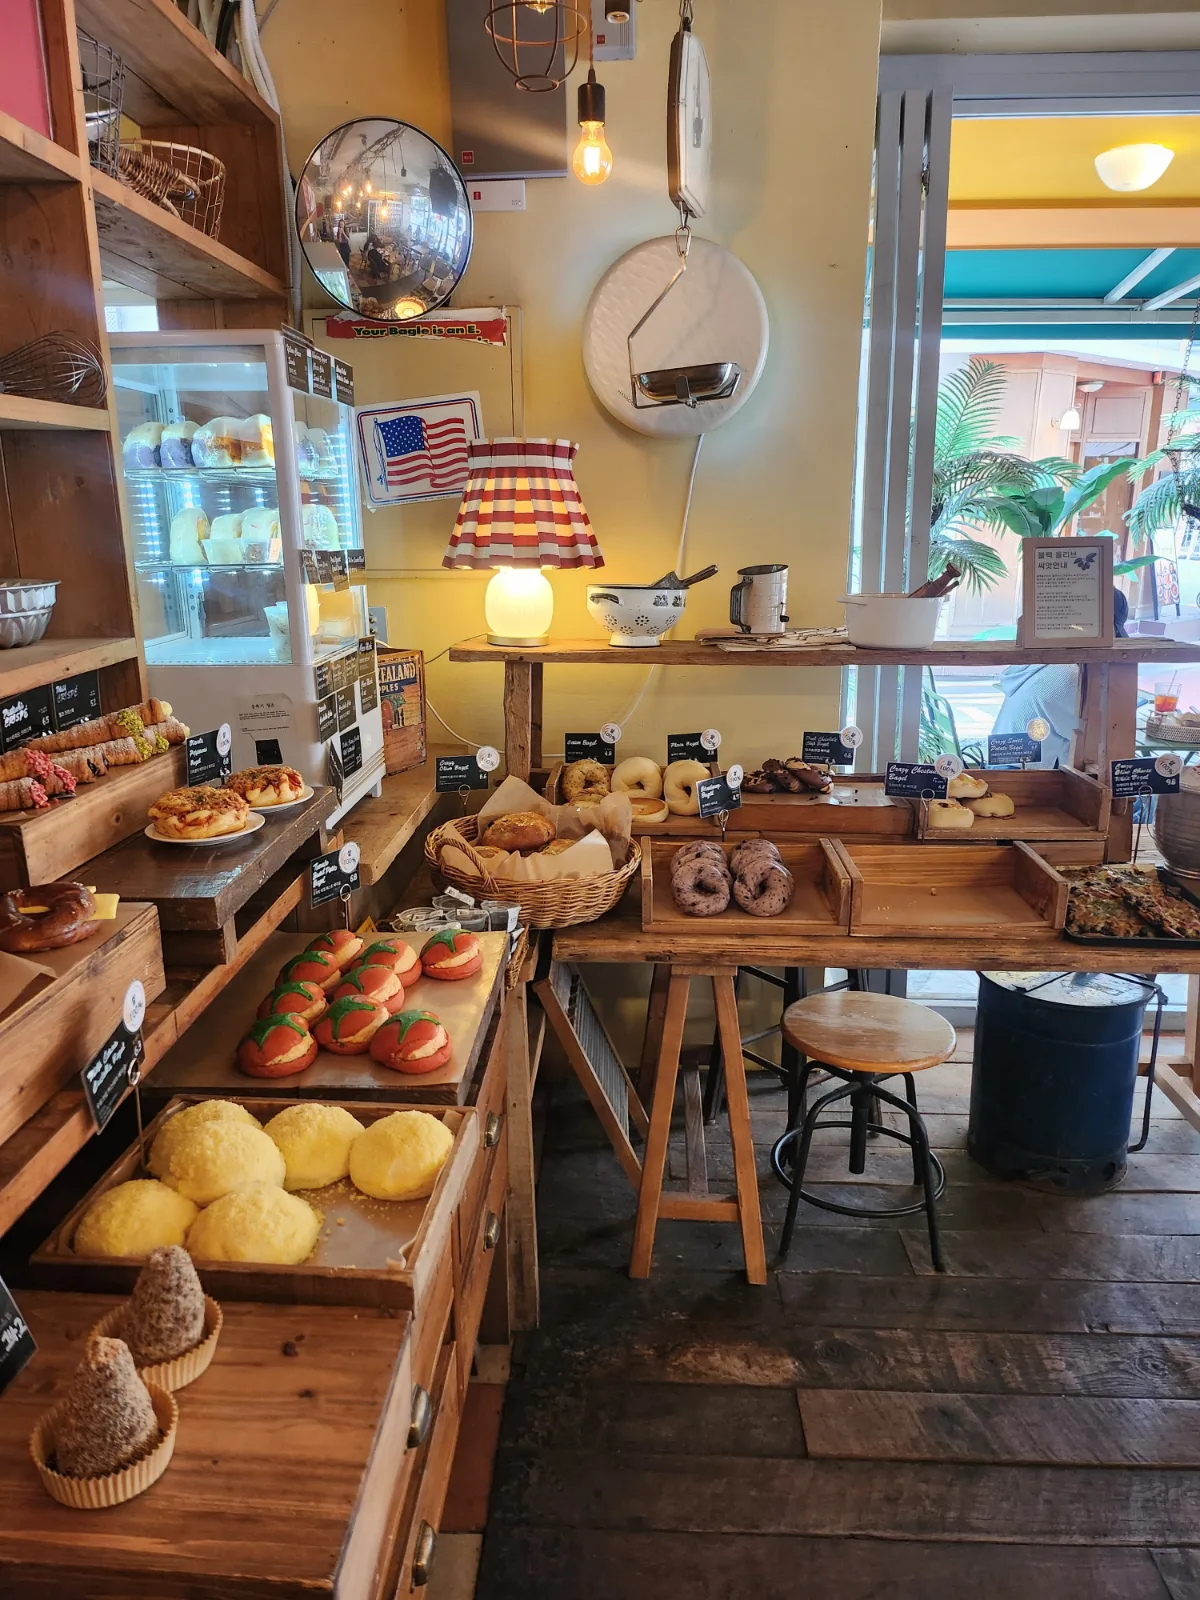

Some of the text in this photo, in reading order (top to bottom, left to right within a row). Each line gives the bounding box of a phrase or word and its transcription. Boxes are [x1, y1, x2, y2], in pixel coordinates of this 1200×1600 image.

[353, 327, 386, 336] Your
[389, 326, 429, 337] Bagle
[432, 326, 444, 335] is
[446, 327, 464, 335] an
[889, 765, 908, 774] Crazy
[940, 765, 956, 774] 100%
[1160, 762, 1172, 774] 100%
[889, 773, 908, 782] Bagel
